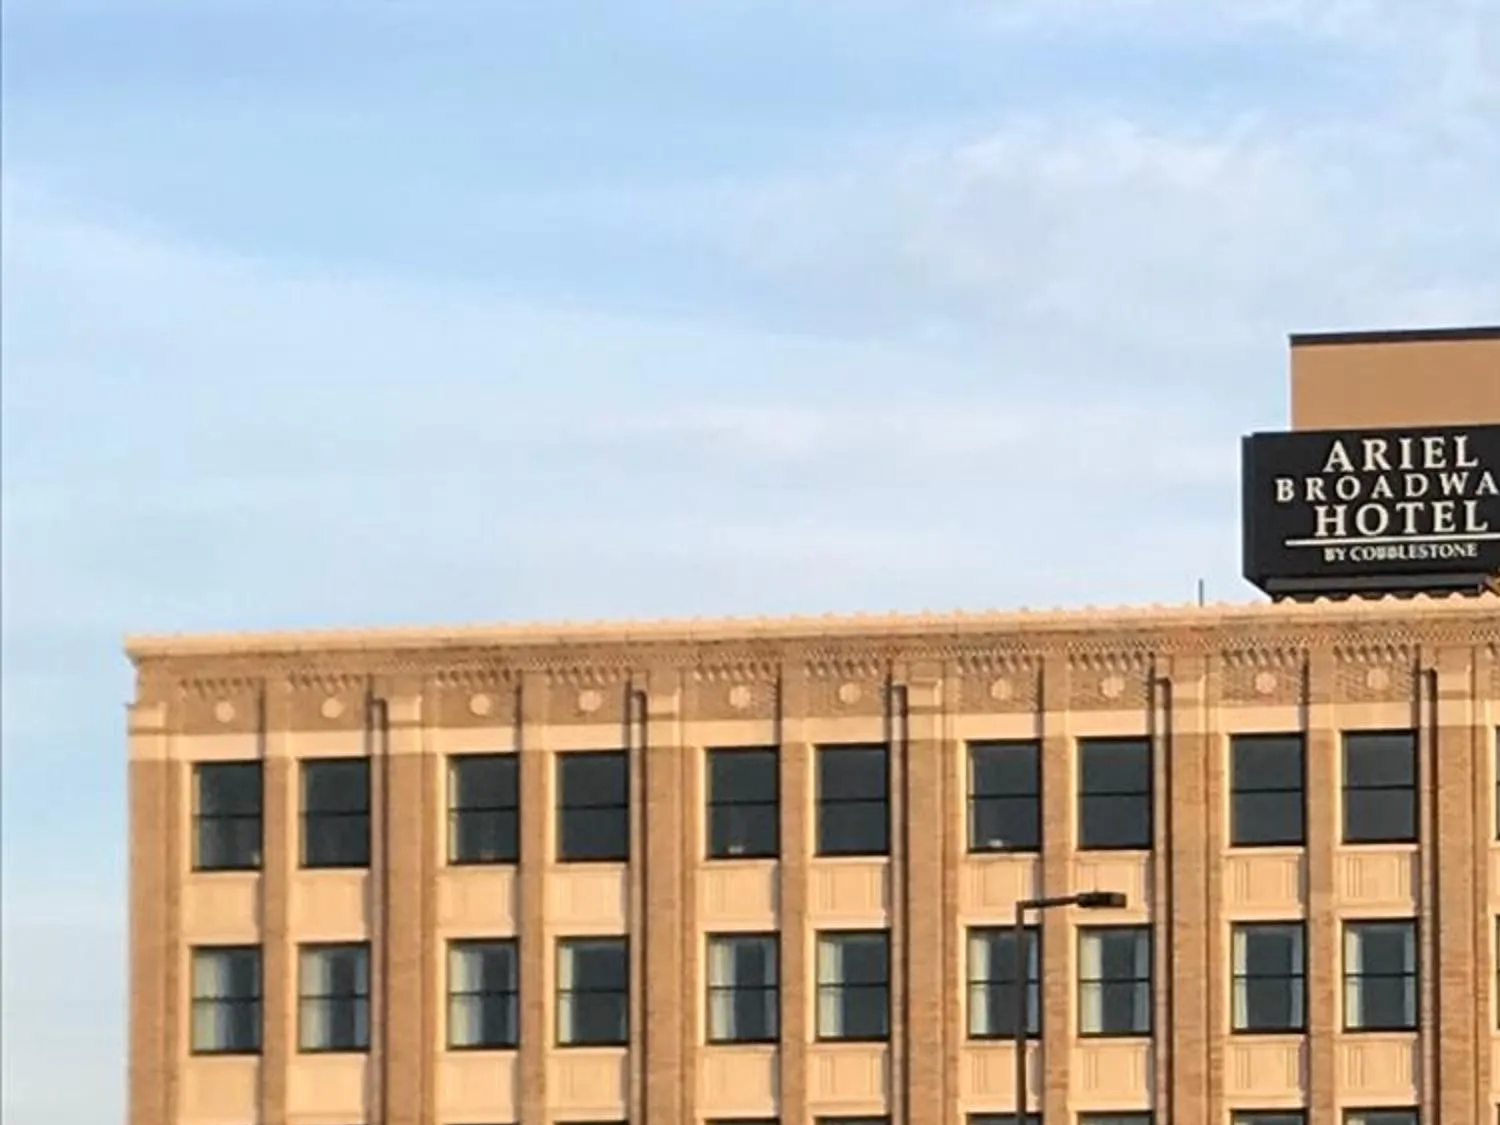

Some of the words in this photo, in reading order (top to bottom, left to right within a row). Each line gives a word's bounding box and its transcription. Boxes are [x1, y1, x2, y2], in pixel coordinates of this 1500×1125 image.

[1324, 435, 1478, 472] ARIEL
[1313, 501, 1488, 536] HOTEL
[1324, 546, 1346, 561] BY
[1350, 543, 1477, 561] COBBLESTONE
